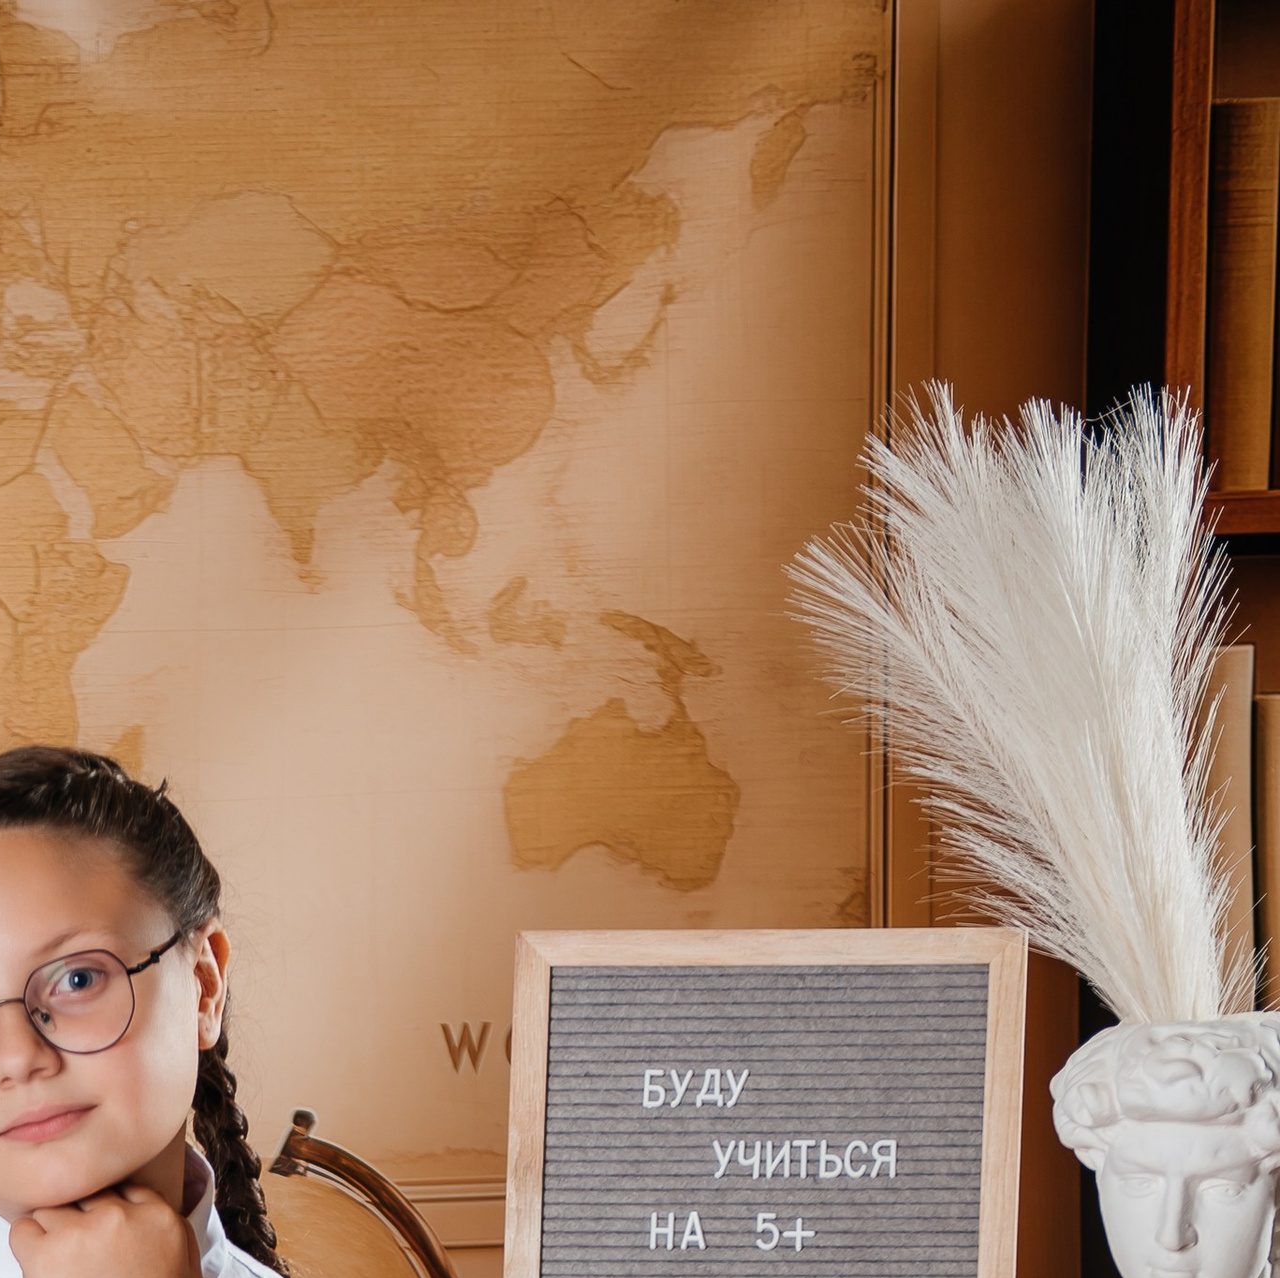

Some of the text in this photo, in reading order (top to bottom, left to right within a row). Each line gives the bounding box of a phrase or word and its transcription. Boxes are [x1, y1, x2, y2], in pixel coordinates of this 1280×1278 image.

[439, 1020, 513, 1075] W
[642, 1067, 750, 1110] БУДУ
[712, 1138, 898, 1181] УЧИТЬСЯ
[648, 1210, 817, 1253] НА 5+
